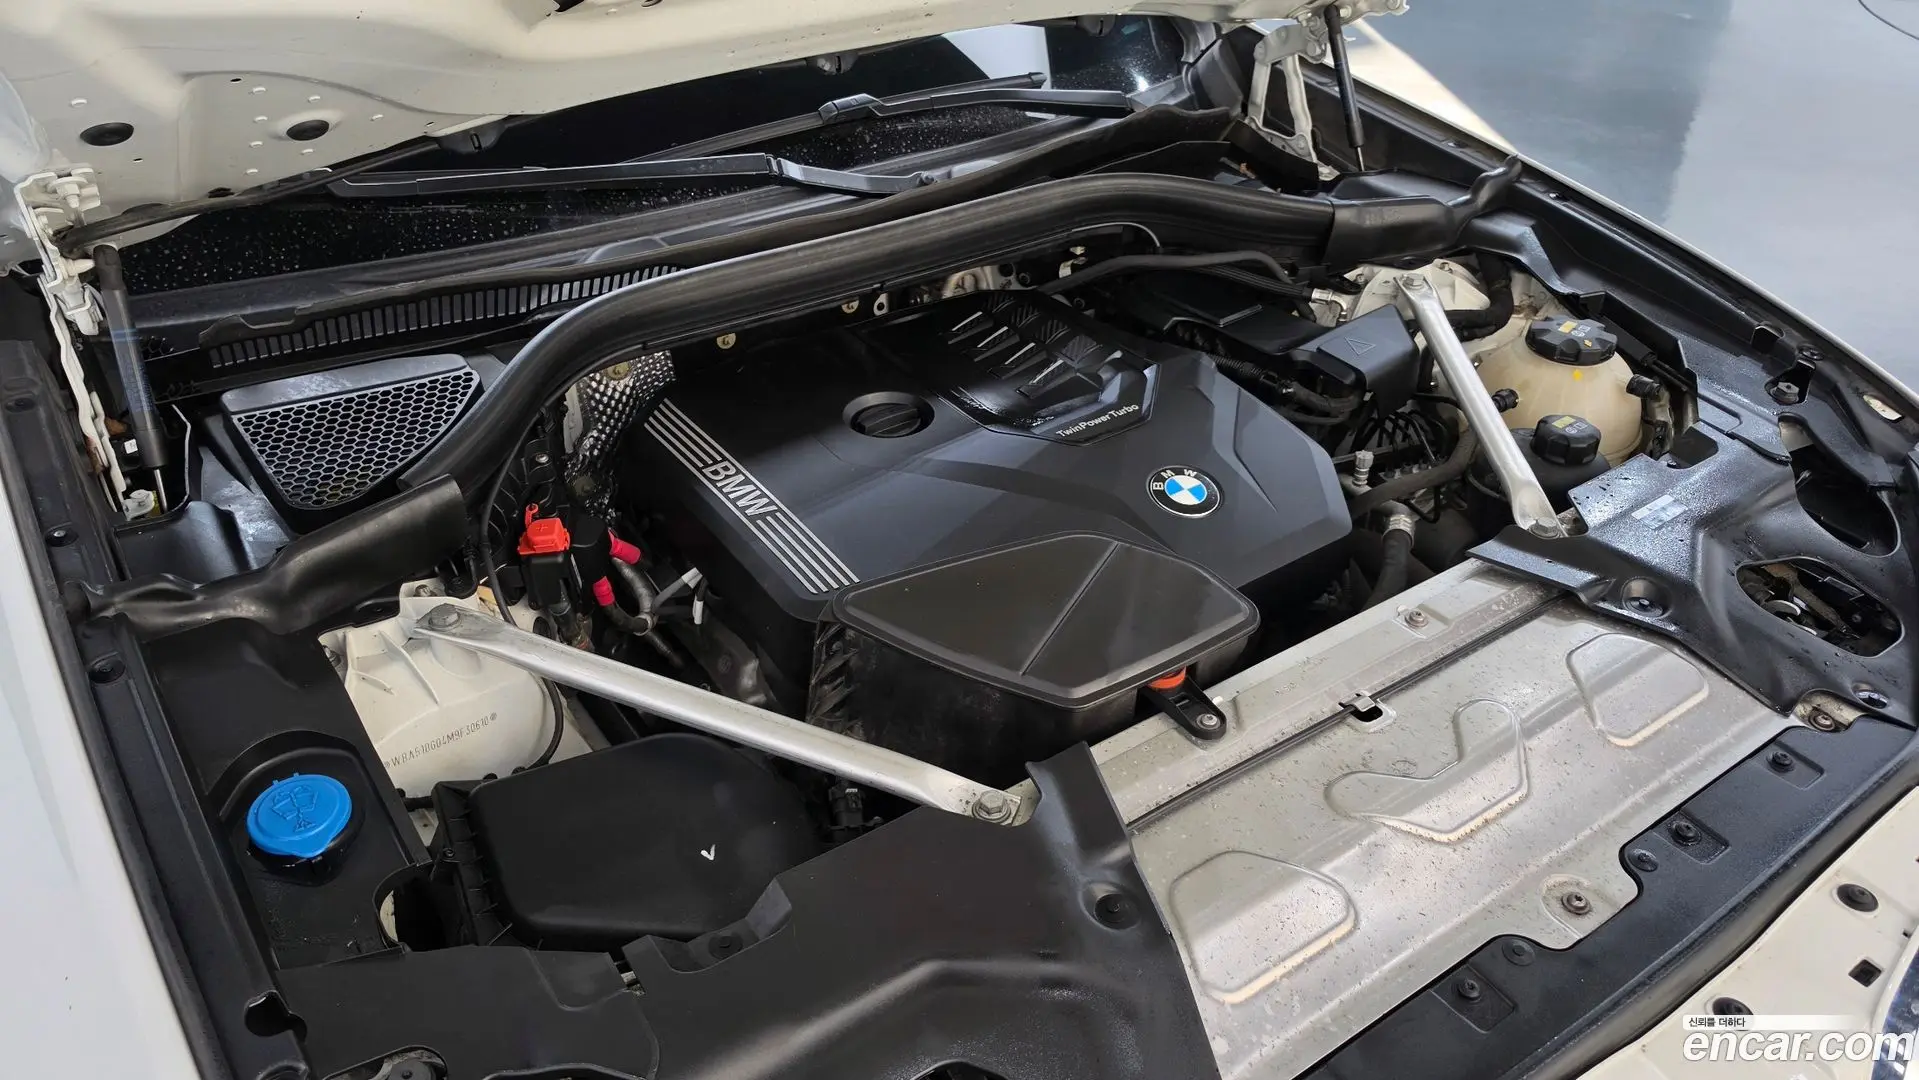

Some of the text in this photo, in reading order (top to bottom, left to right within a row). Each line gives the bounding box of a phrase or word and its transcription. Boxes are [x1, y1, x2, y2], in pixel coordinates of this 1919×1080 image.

[1056, 404, 1139, 437] TwinPower Turbo
[702, 460, 778, 516] BMW
[1152, 469, 1197, 490] BMW
